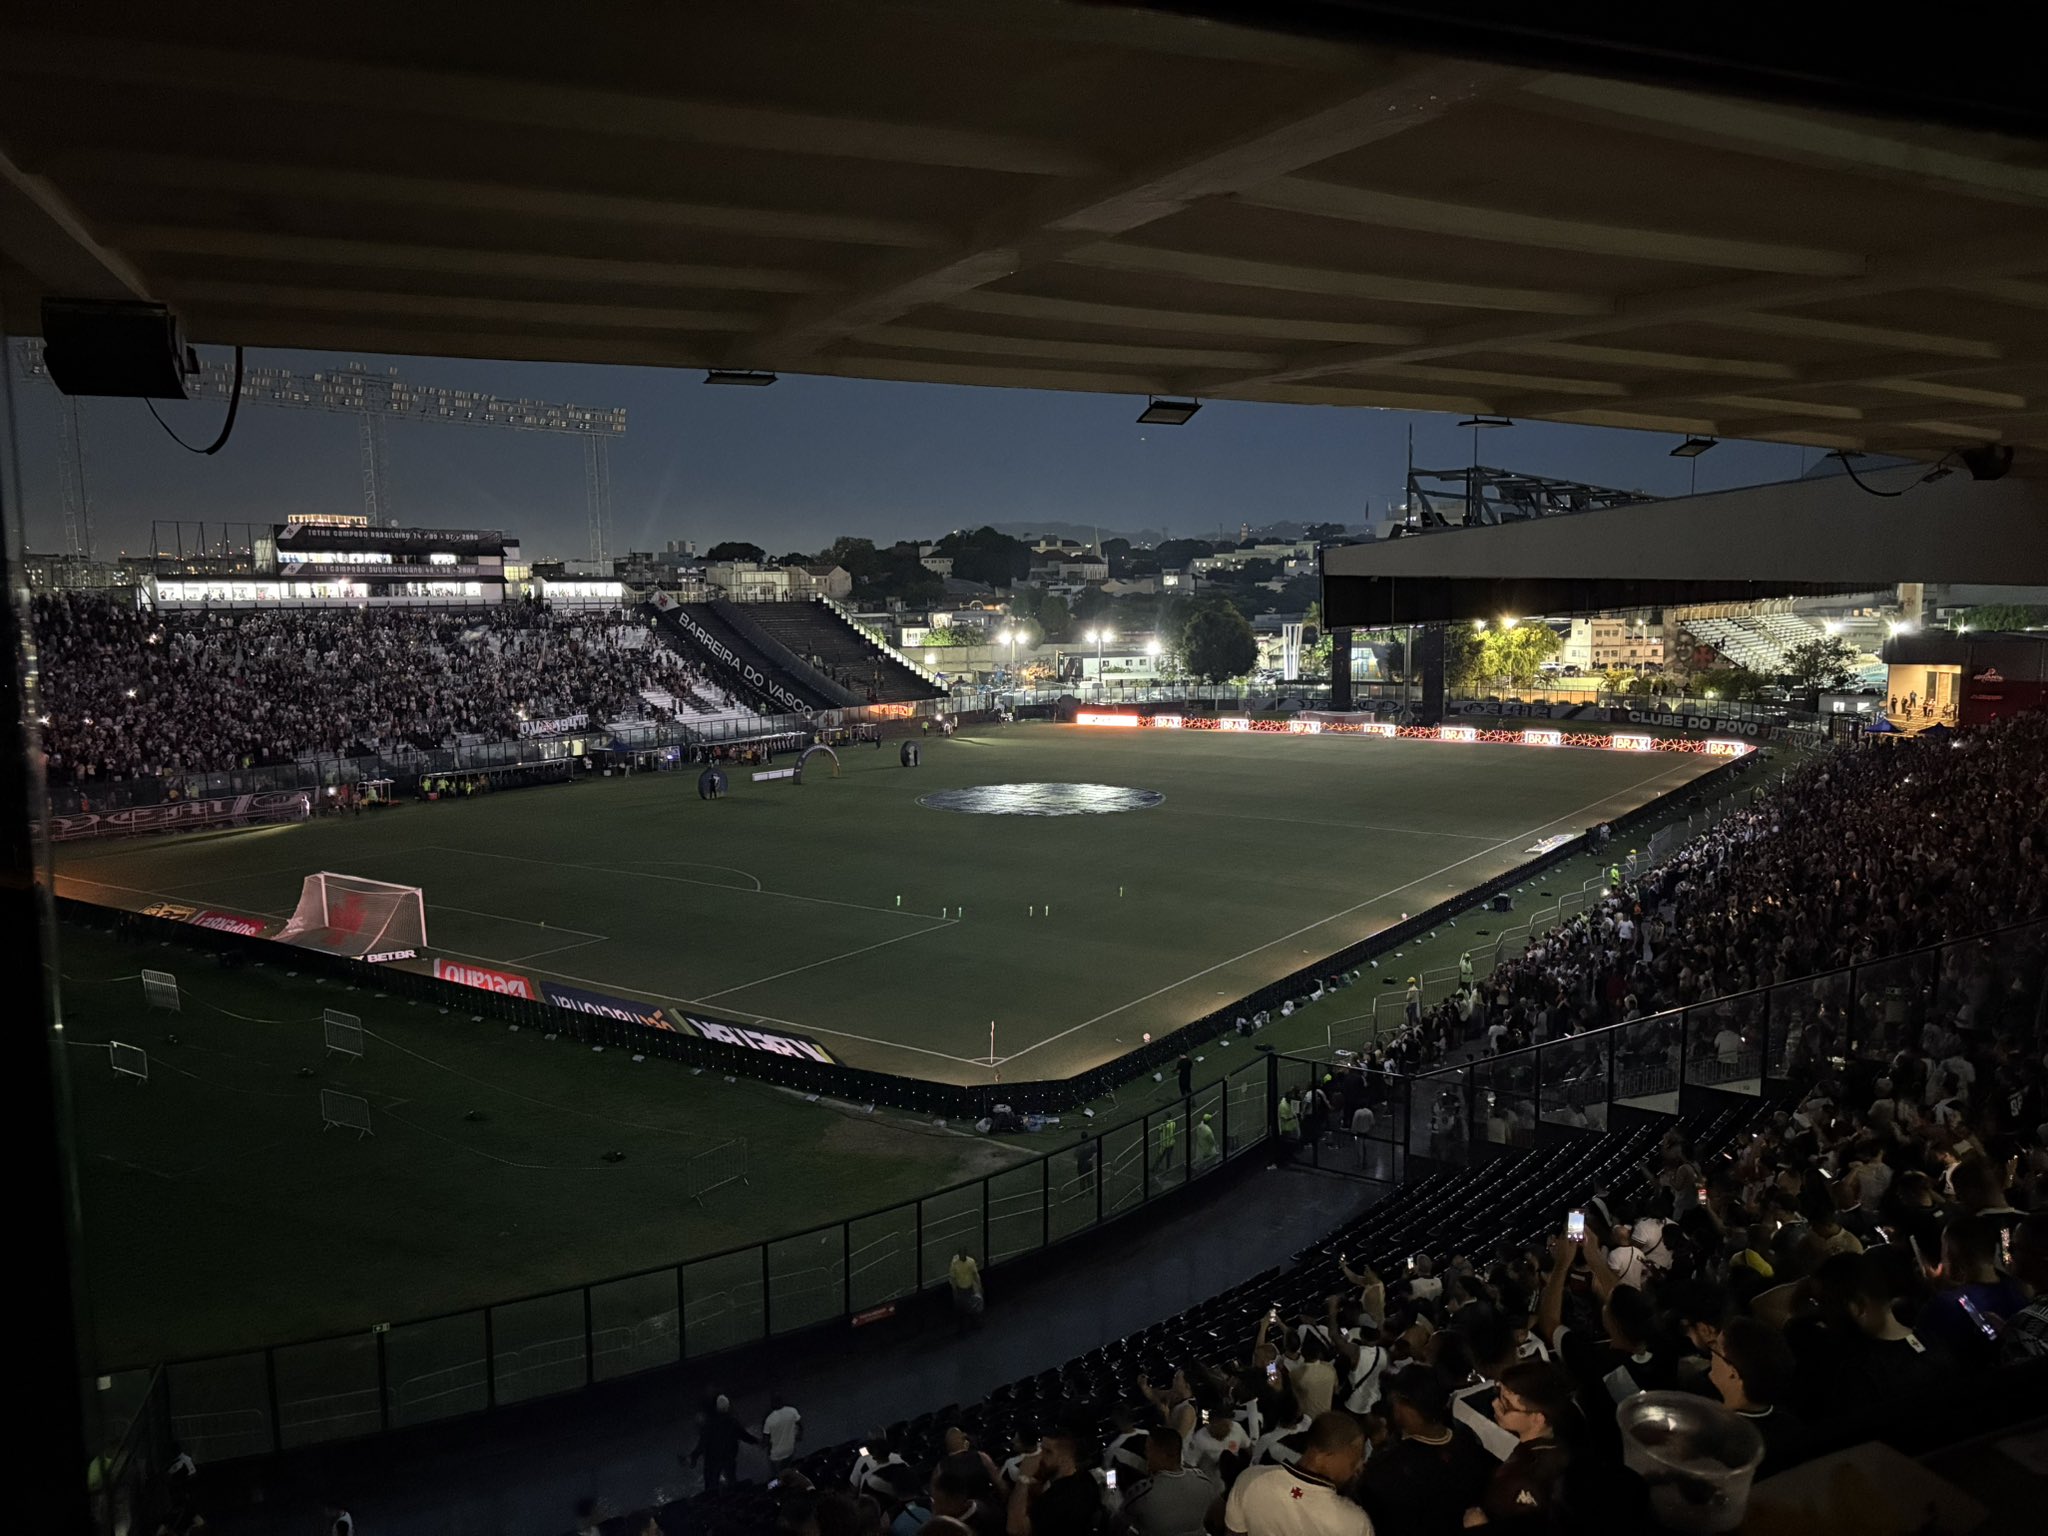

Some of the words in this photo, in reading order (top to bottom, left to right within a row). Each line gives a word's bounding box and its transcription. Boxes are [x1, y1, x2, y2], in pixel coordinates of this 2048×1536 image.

[678, 612, 741, 672] BARREIRA
[743, 664, 765, 687] DO
[768, 679, 814, 720] VASCO
[1628, 710, 1684, 728] CLUBE
[1688, 716, 1711, 730] DO
[1715, 720, 1758, 736] POVO
[1445, 729, 1473, 741] BRAX
[1529, 732, 1558, 744] BRAX
[1617, 737, 1648, 750] BRAX
[1711, 743, 1743, 756] BRAX
